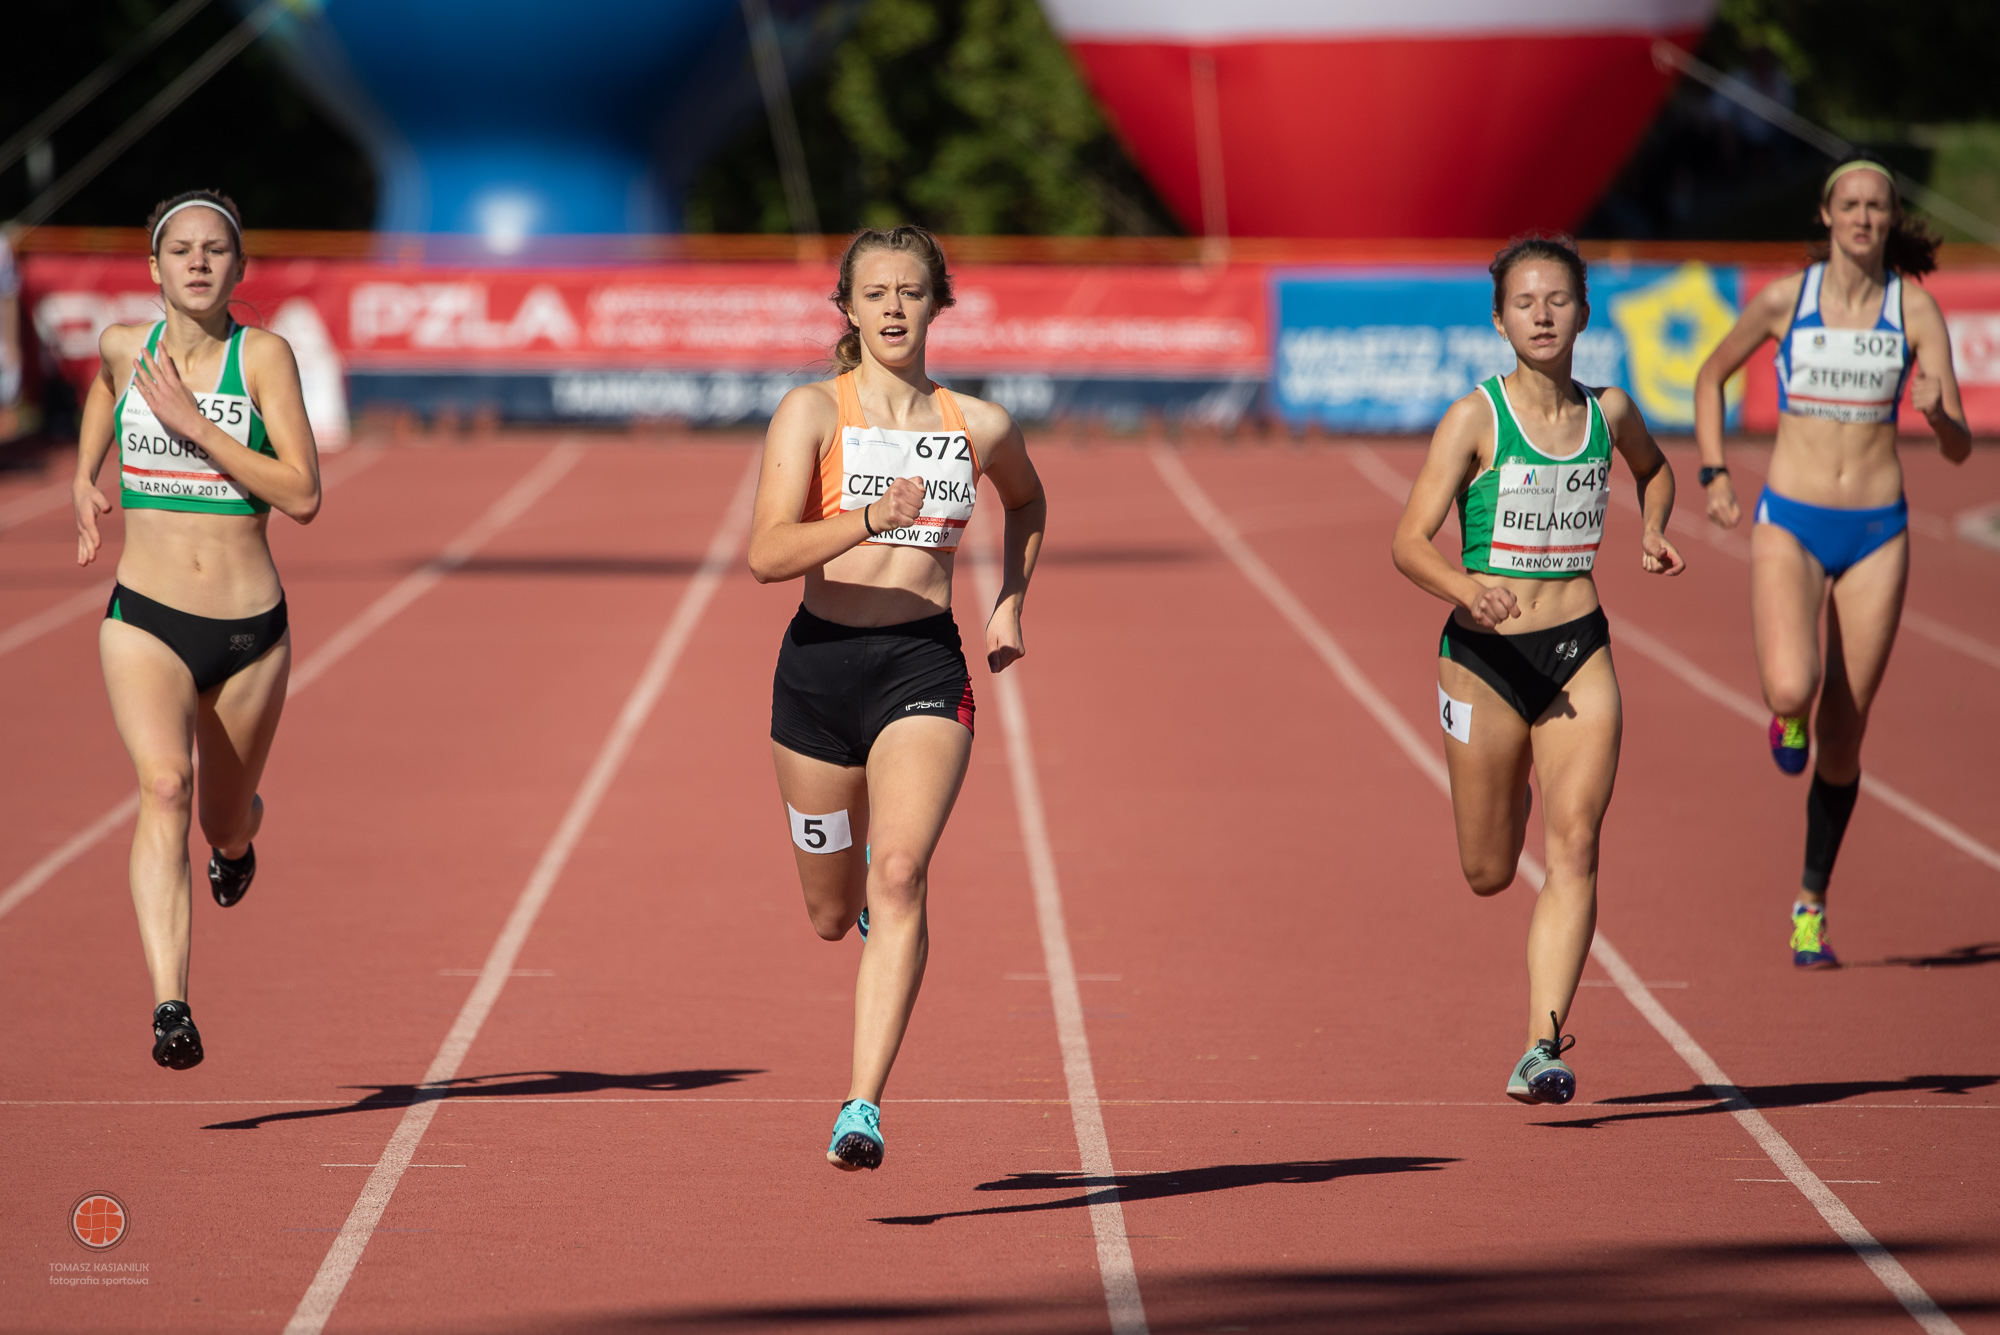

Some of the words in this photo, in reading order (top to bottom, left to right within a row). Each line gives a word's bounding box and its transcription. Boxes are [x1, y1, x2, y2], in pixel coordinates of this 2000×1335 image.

[349, 282, 579, 348] PZLA
[1854, 335, 1898, 357] 502
[1808, 366, 1884, 391] STĘPIEŃ
[127, 433, 214, 461] SADURS
[915, 435, 970, 461] 672
[138, 480, 194, 496] TARNÓW
[198, 485, 229, 496] 2019
[1503, 486, 1555, 495] MAŁOPOLSKA
[1566, 466, 1607, 493] 649
[1503, 510, 1604, 531] BIELAKOW
[924, 530, 949, 544] 2019
[1511, 554, 1563, 569] TARNÓW
[1566, 555, 1592, 569] 2019
[1442, 699, 1454, 730] 4
[803, 818, 827, 849] 5
